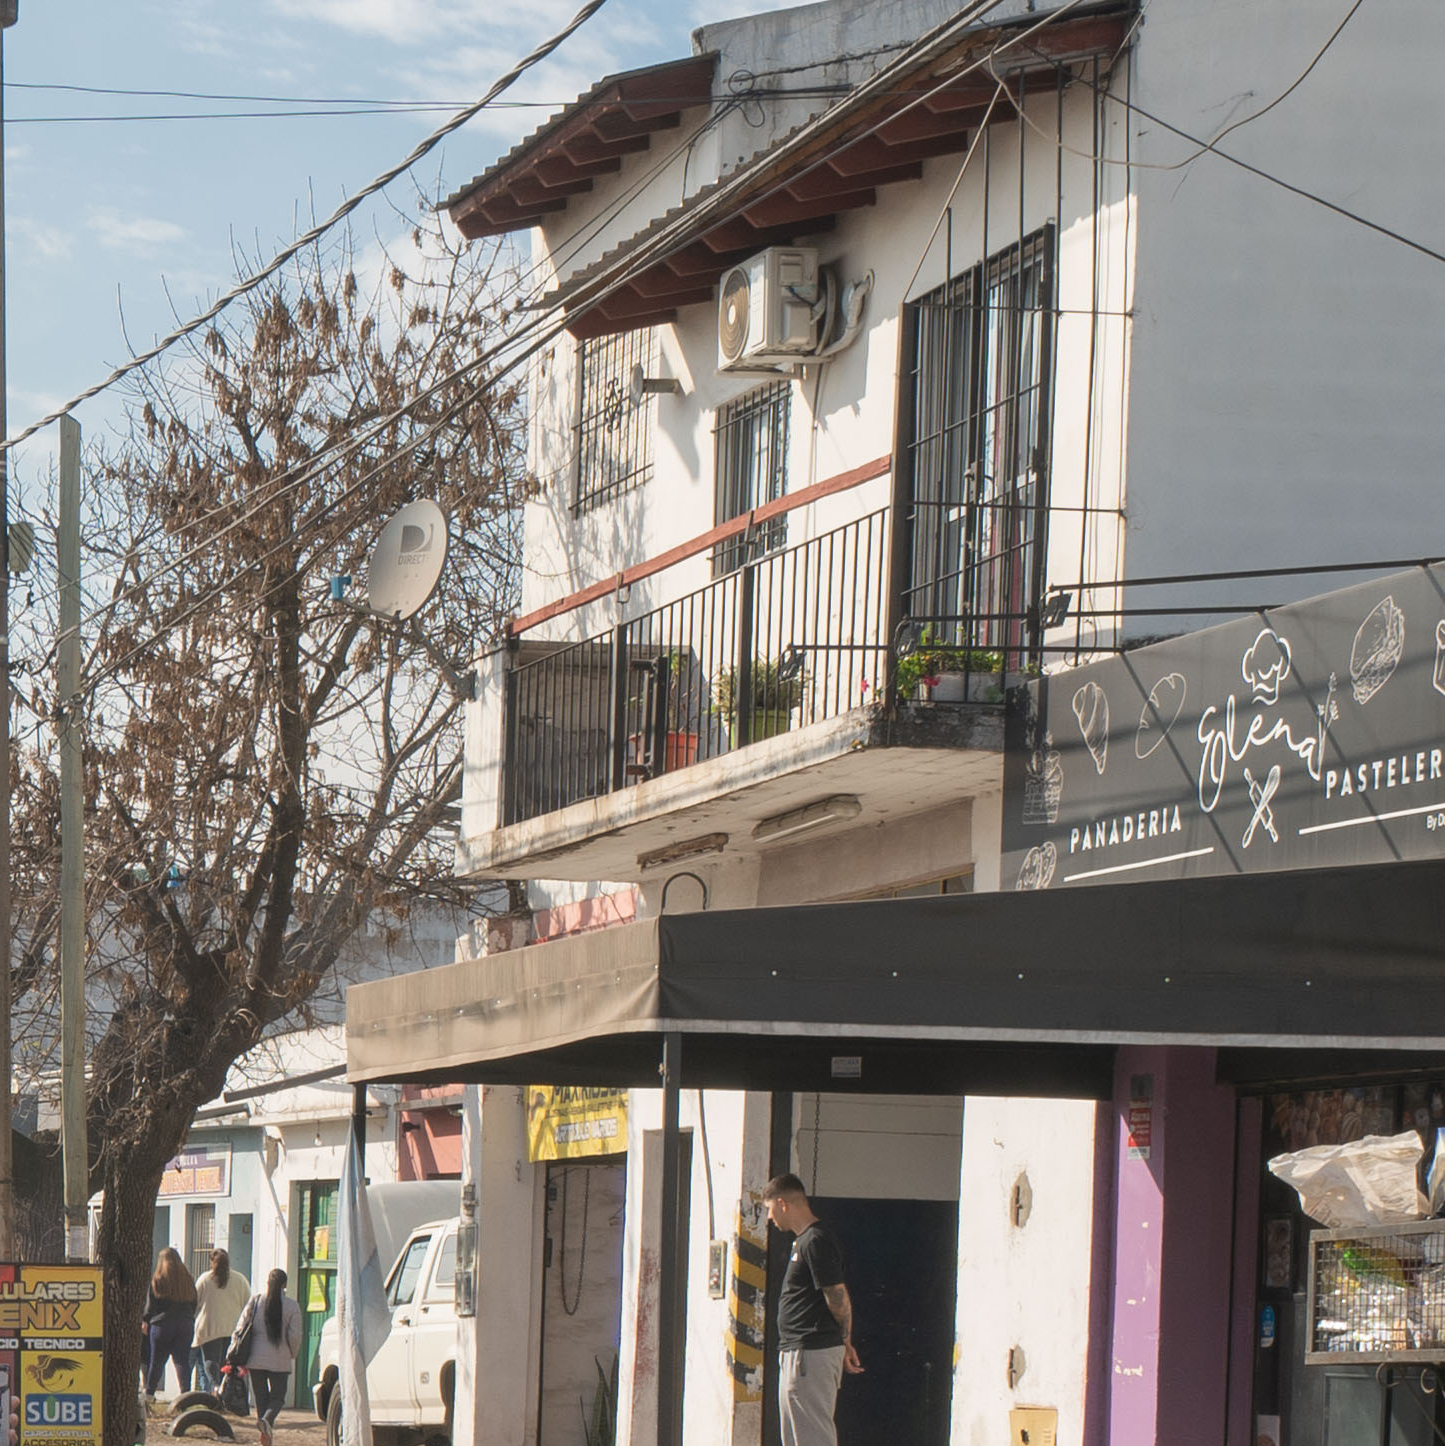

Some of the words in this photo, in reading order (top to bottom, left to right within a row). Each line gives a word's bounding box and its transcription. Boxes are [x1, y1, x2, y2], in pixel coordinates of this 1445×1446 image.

[1197, 694, 1323, 813] Elena
[1069, 804, 1183, 853] PANADERIA
[24, 1338, 86, 1350] TECNICO
[26, 1396, 92, 1424] SUBE
